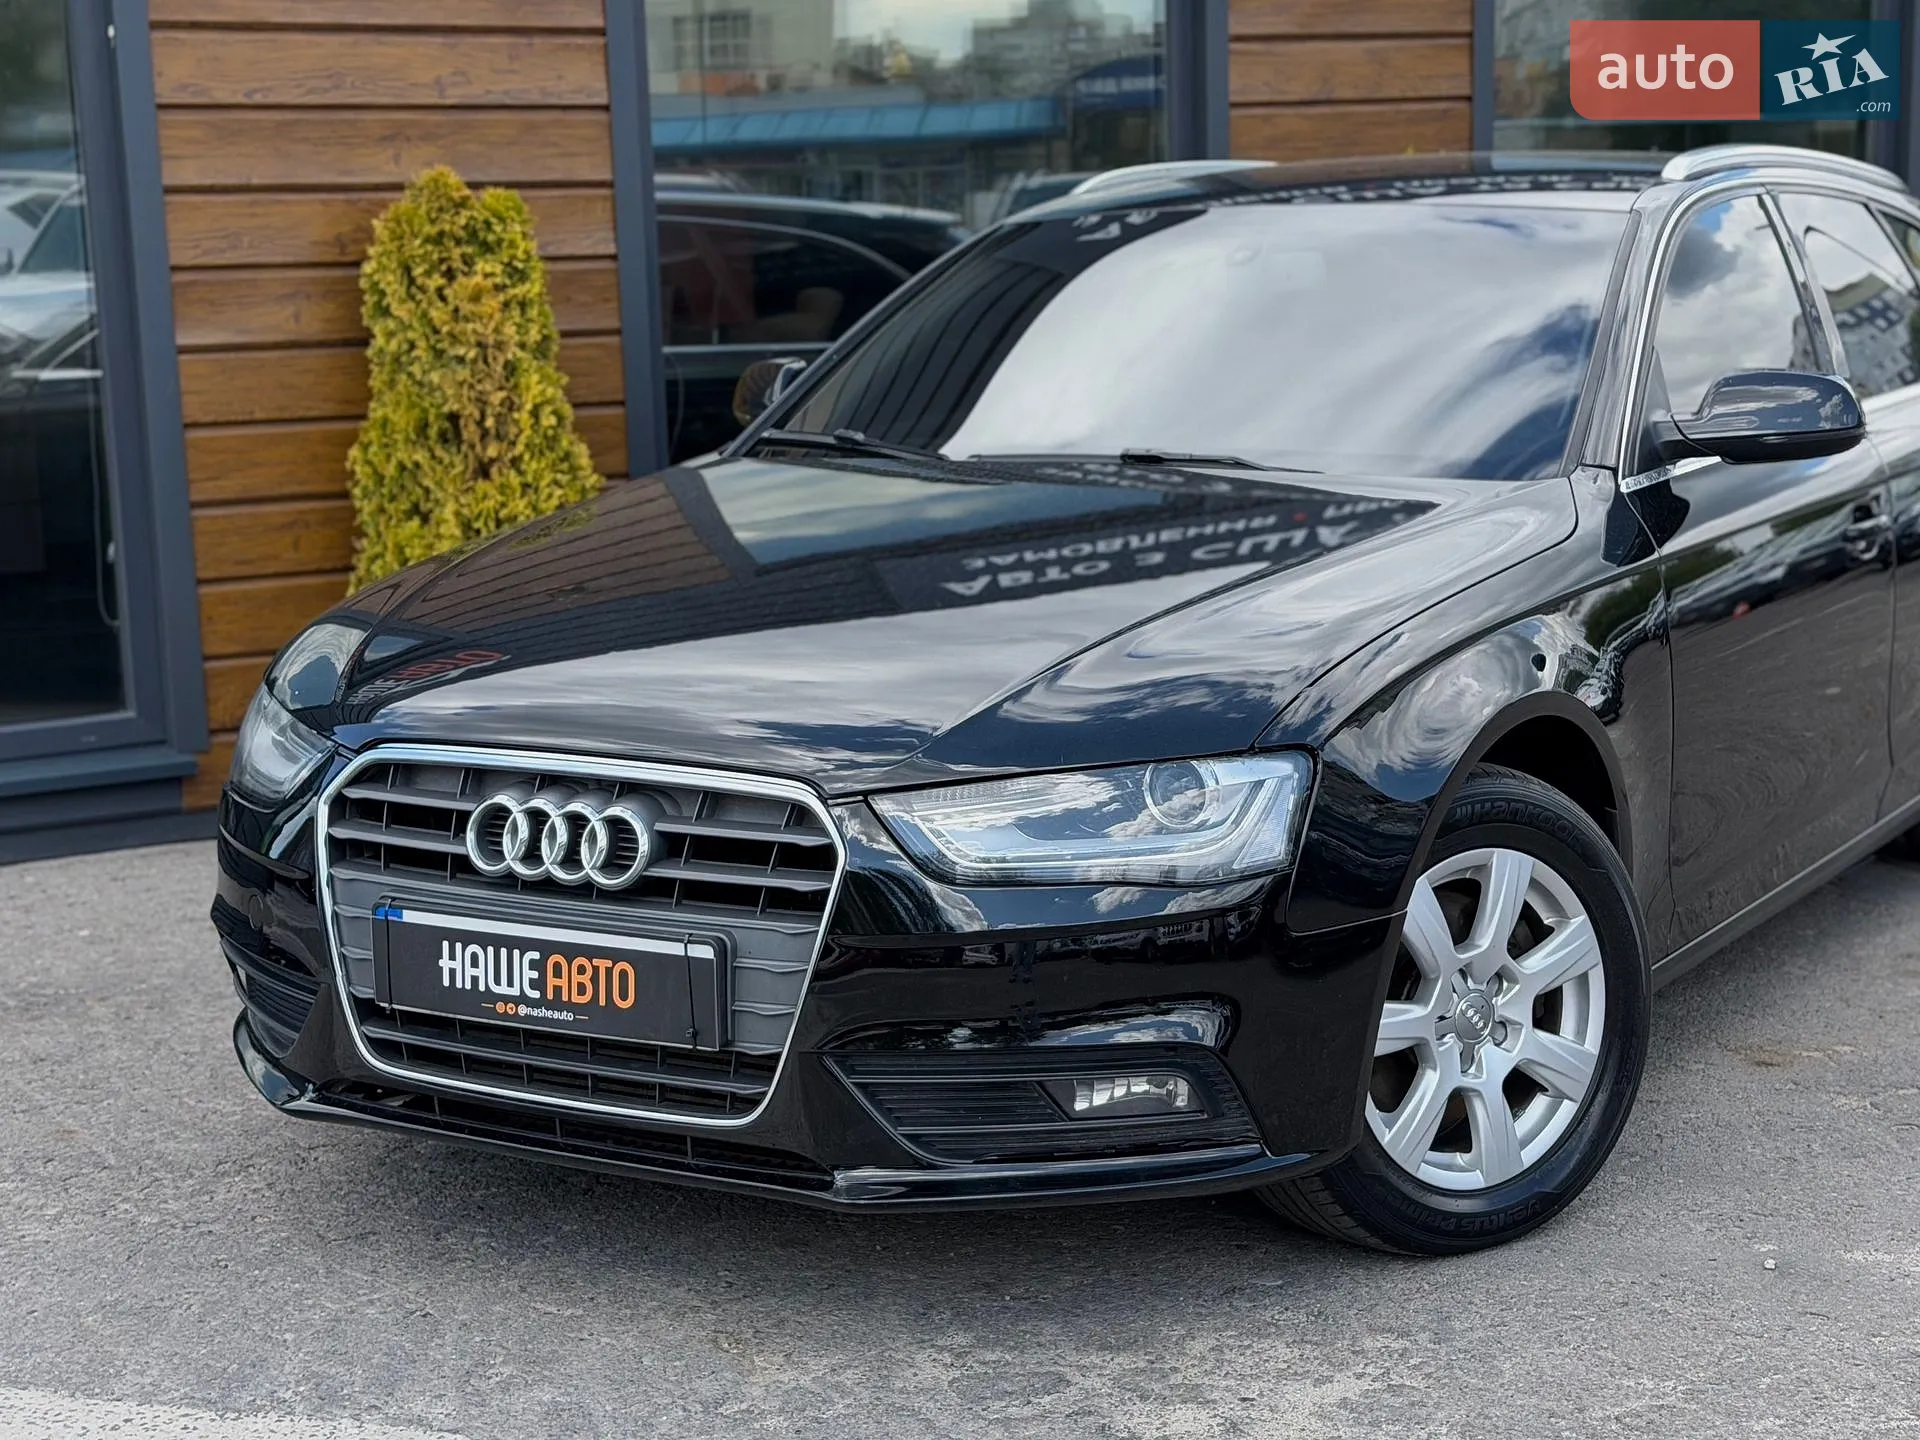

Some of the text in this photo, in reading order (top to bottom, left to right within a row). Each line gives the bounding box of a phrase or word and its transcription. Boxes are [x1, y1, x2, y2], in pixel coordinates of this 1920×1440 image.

[439, 940, 635, 1008] НАШЕ АВТО
[518, 1004, 574, 1021] @nasheauto
